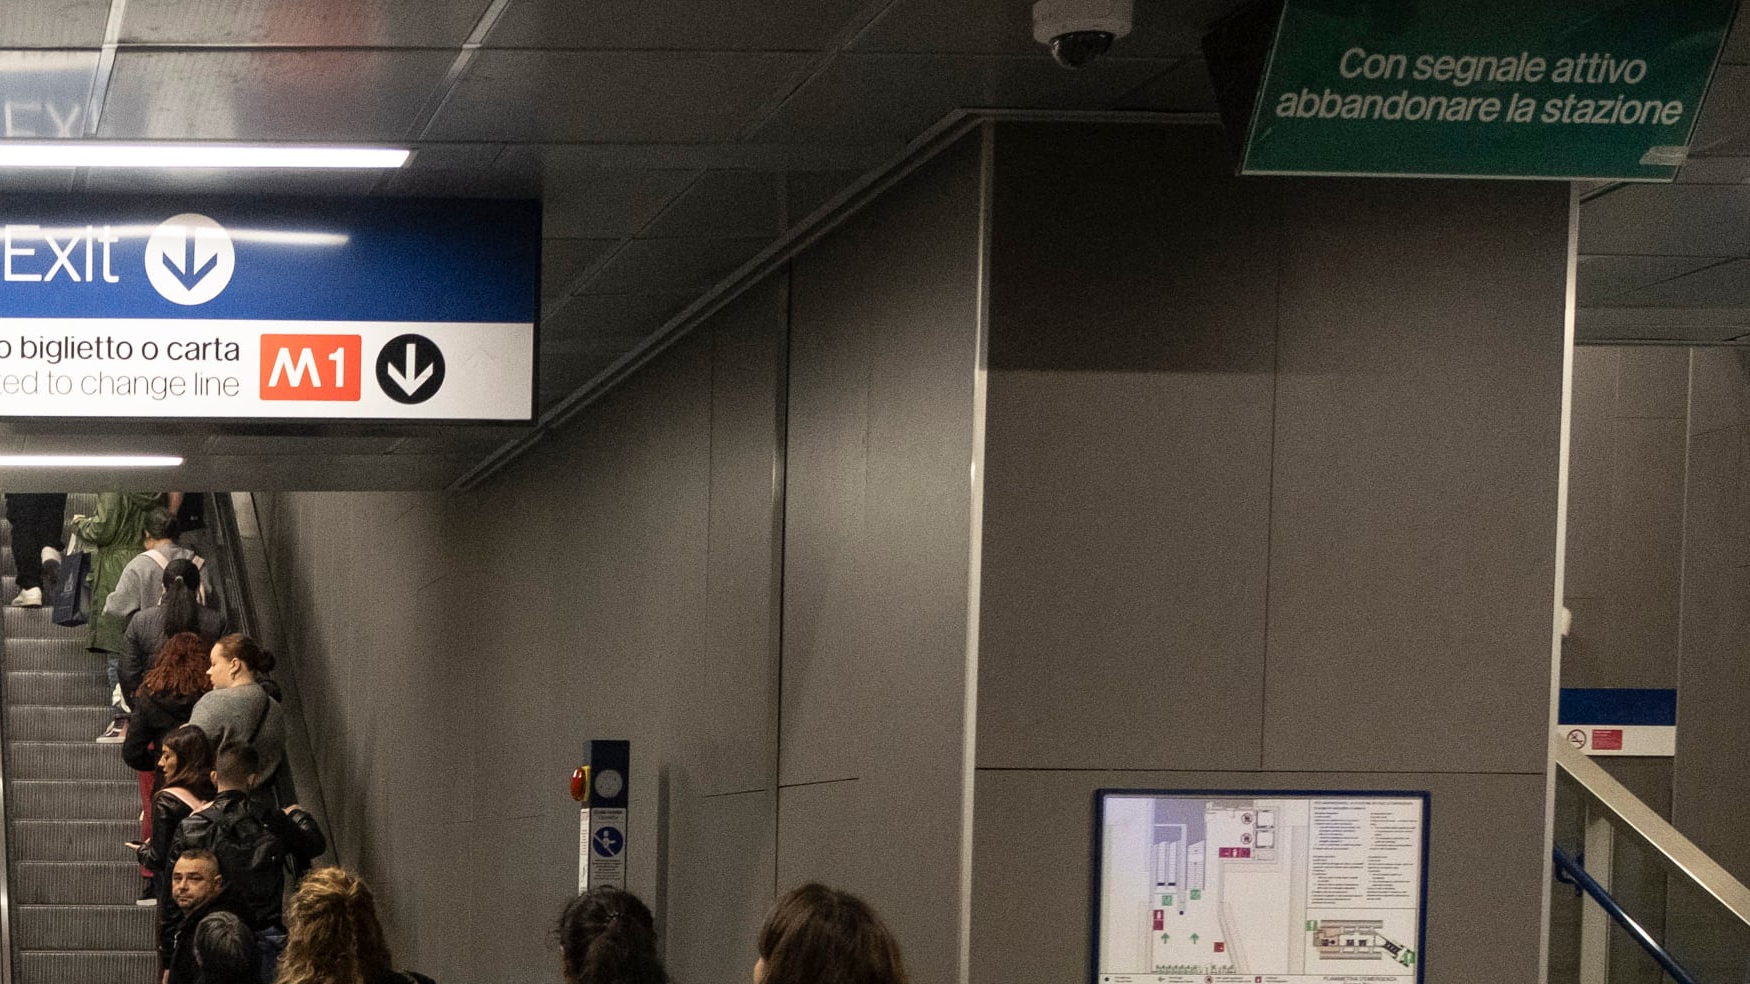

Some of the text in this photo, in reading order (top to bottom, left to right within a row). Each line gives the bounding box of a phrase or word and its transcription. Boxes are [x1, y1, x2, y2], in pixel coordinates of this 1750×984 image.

[1338, 47, 1648, 87] Con segnale attivo
[1275, 88, 1684, 126] abbandonare la stazione
[2, 223, 120, 283] Exit
[20, 335, 133, 365] biglietto
[141, 340, 159, 361] o
[166, 337, 241, 362] carta
[267, 346, 346, 388] M1
[47, 370, 74, 396] to
[80, 371, 187, 401] change
[194, 371, 241, 397] line
